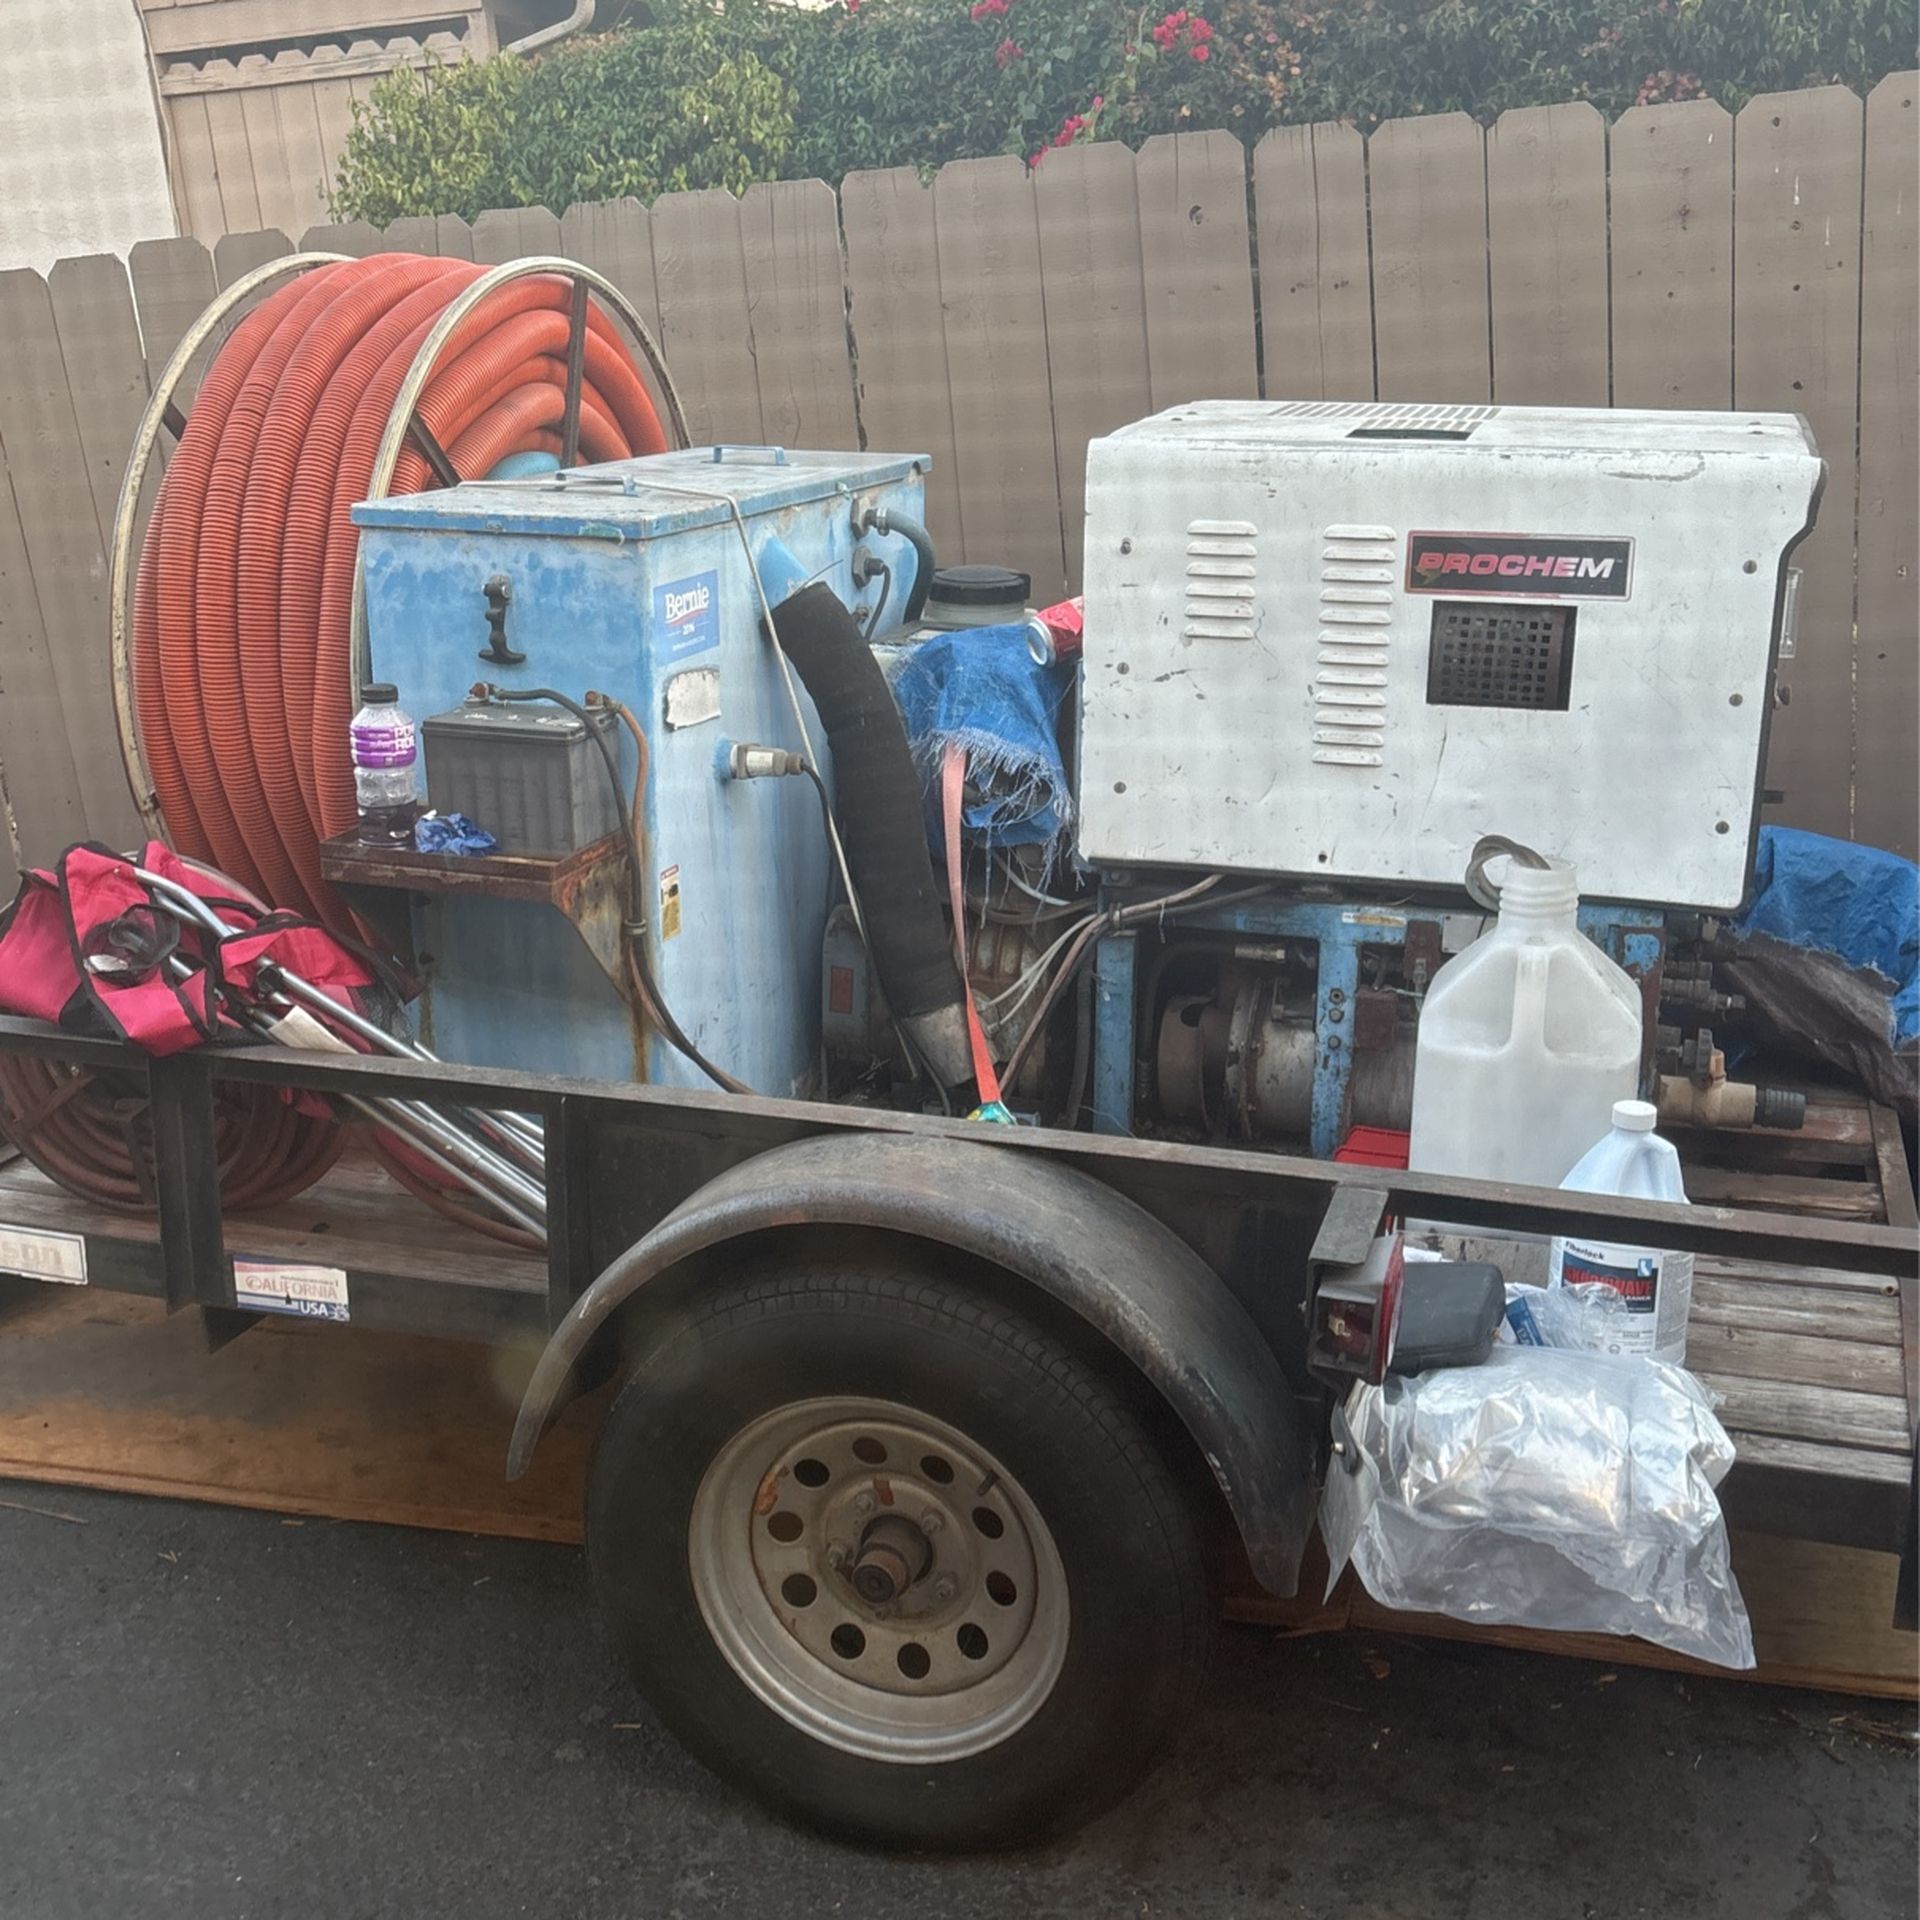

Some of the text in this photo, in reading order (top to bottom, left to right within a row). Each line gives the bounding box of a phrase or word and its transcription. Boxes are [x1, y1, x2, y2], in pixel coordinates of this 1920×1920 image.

[1416, 552, 1615, 579] PROCHEM
[665, 581, 710, 620] Bernie
[1565, 1240, 1605, 1260] Fiberlock
[245, 1275, 338, 1299] CALIFORNIA
[300, 1301, 329, 1316] USA
